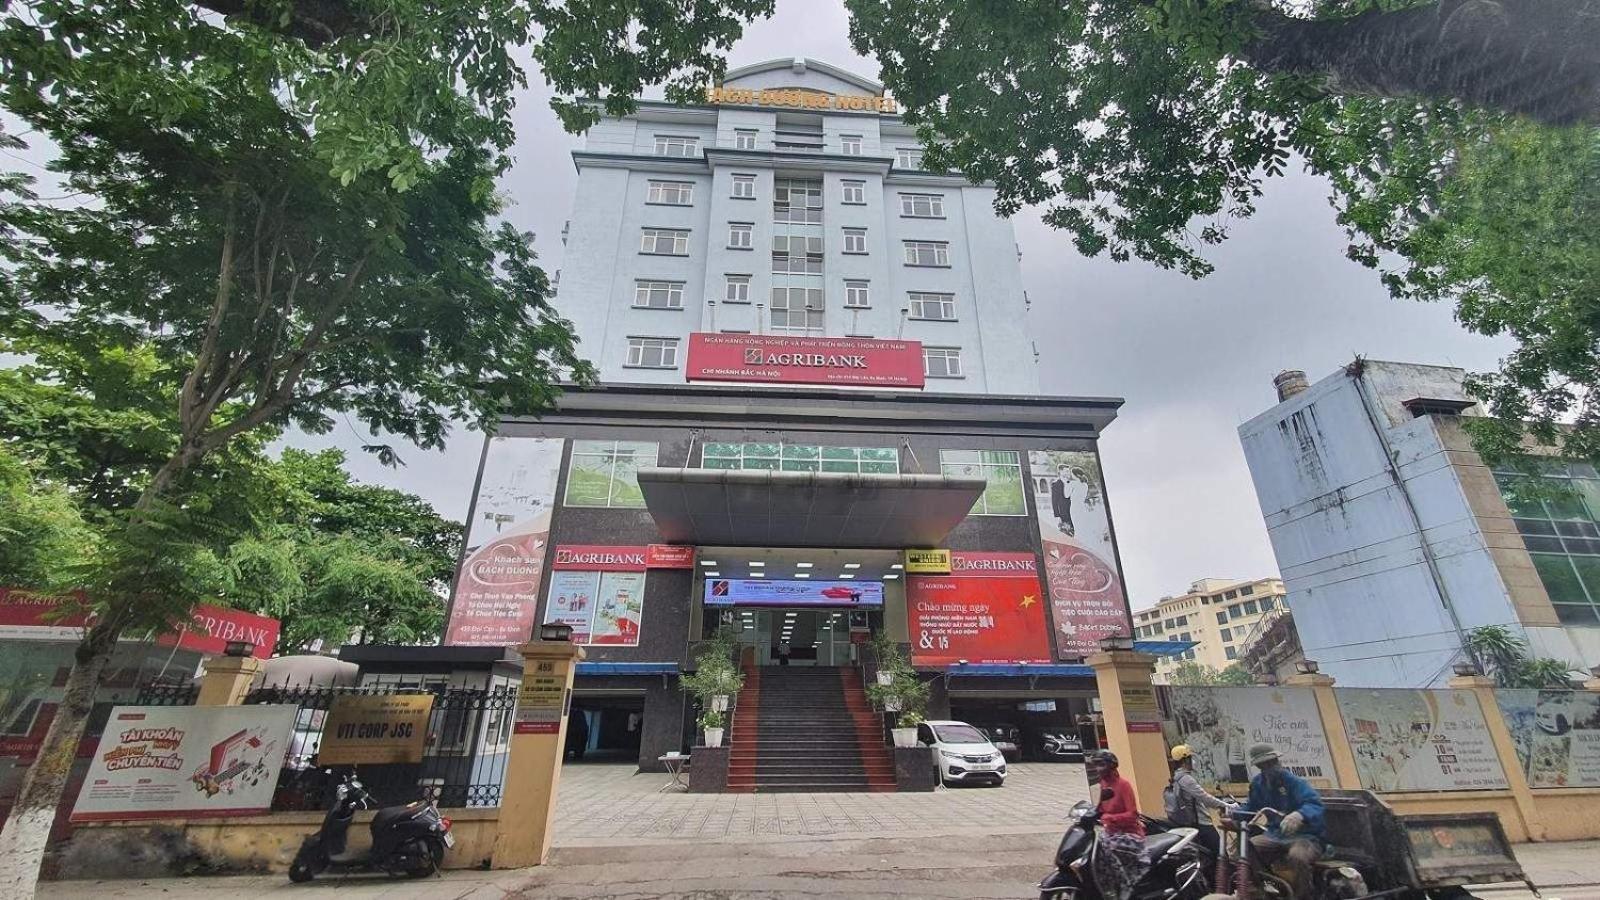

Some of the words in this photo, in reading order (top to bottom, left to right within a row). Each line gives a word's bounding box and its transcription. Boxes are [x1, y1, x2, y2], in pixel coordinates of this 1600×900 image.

[835, 95, 896, 114] HOTEL
[766, 353, 868, 368] AGRIBANK
[570, 553, 645, 565] AGRIBANK
[965, 560, 1037, 571] AGRIBANK
[942, 602, 968, 614] mừng
[919, 630, 934, 649] &
[121, 727, 141, 744] TÀI
[358, 721, 389, 738] CORP
[390, 721, 413, 738] JSC
